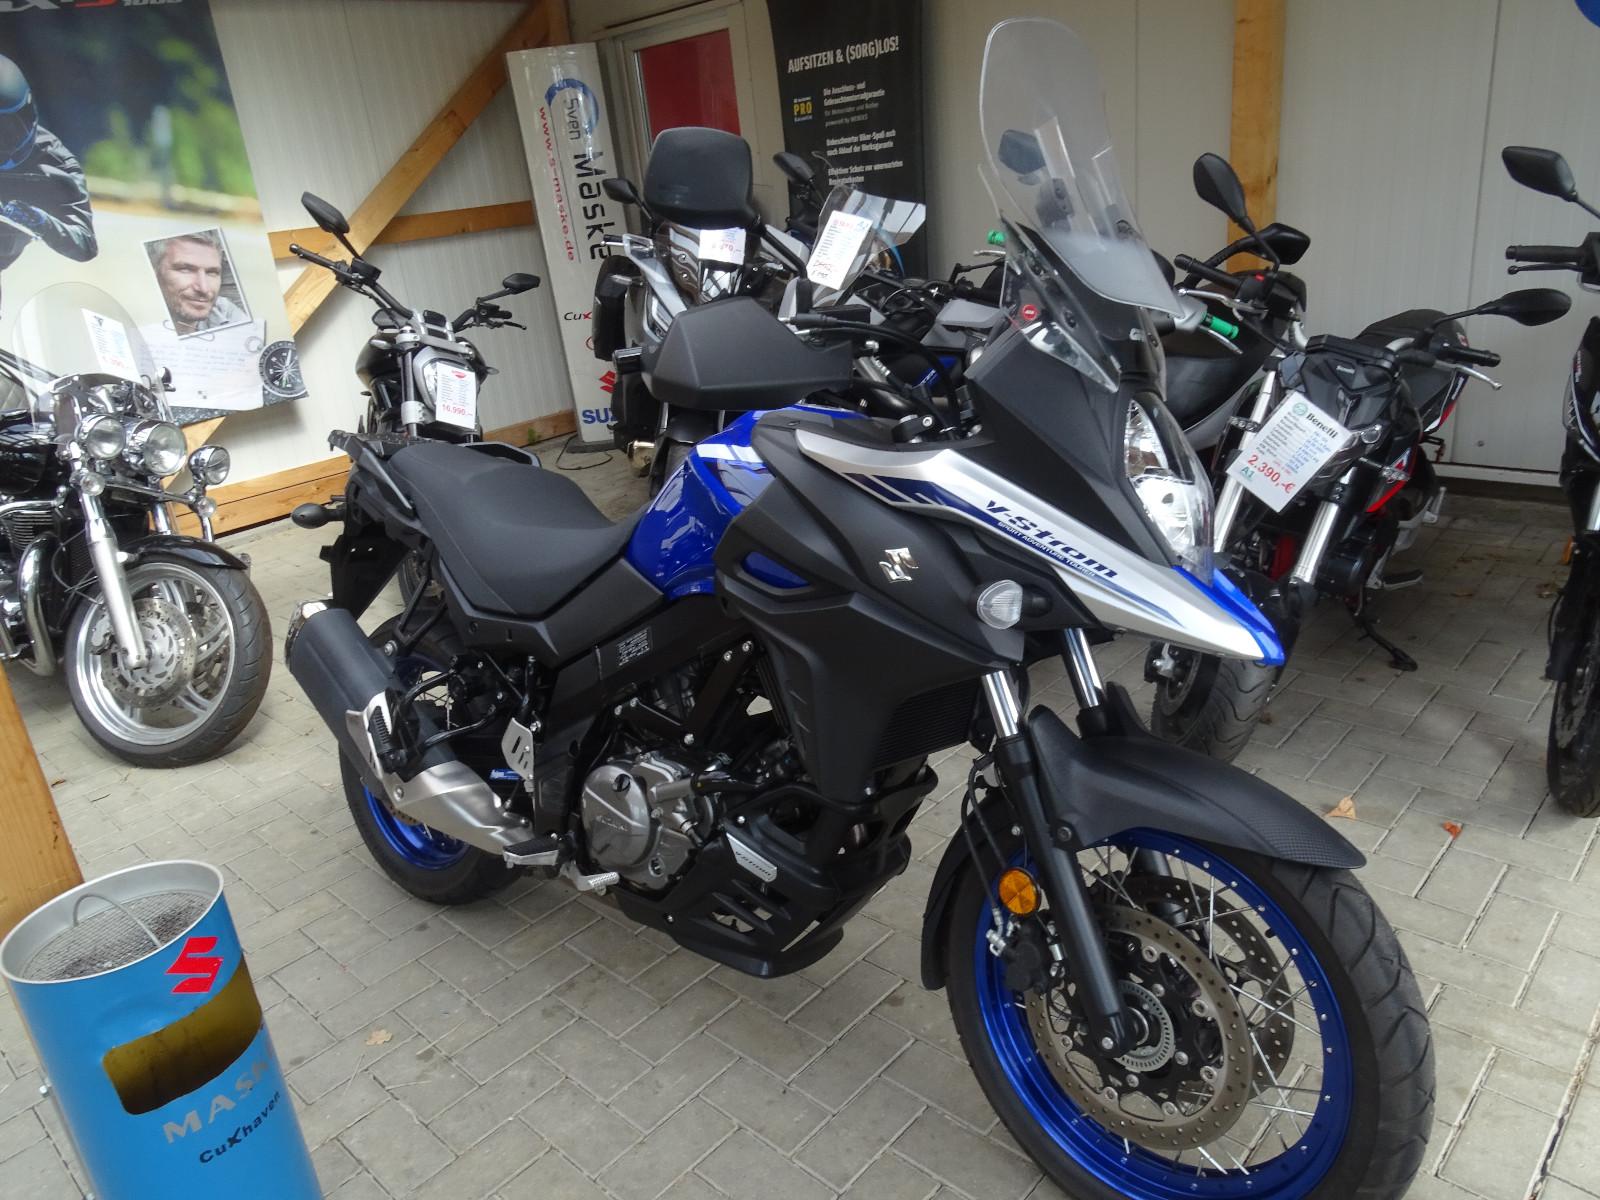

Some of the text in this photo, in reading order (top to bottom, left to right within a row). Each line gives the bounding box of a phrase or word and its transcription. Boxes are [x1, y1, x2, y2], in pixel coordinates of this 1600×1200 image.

[788, 36, 899, 73] AUFSITZEN & (SORG)LOS!
[565, 96, 581, 141] Sven
[793, 101, 813, 116] PRO
[1305, 412, 1339, 439] Benelli
[997, 521, 1022, 538] SPORT
